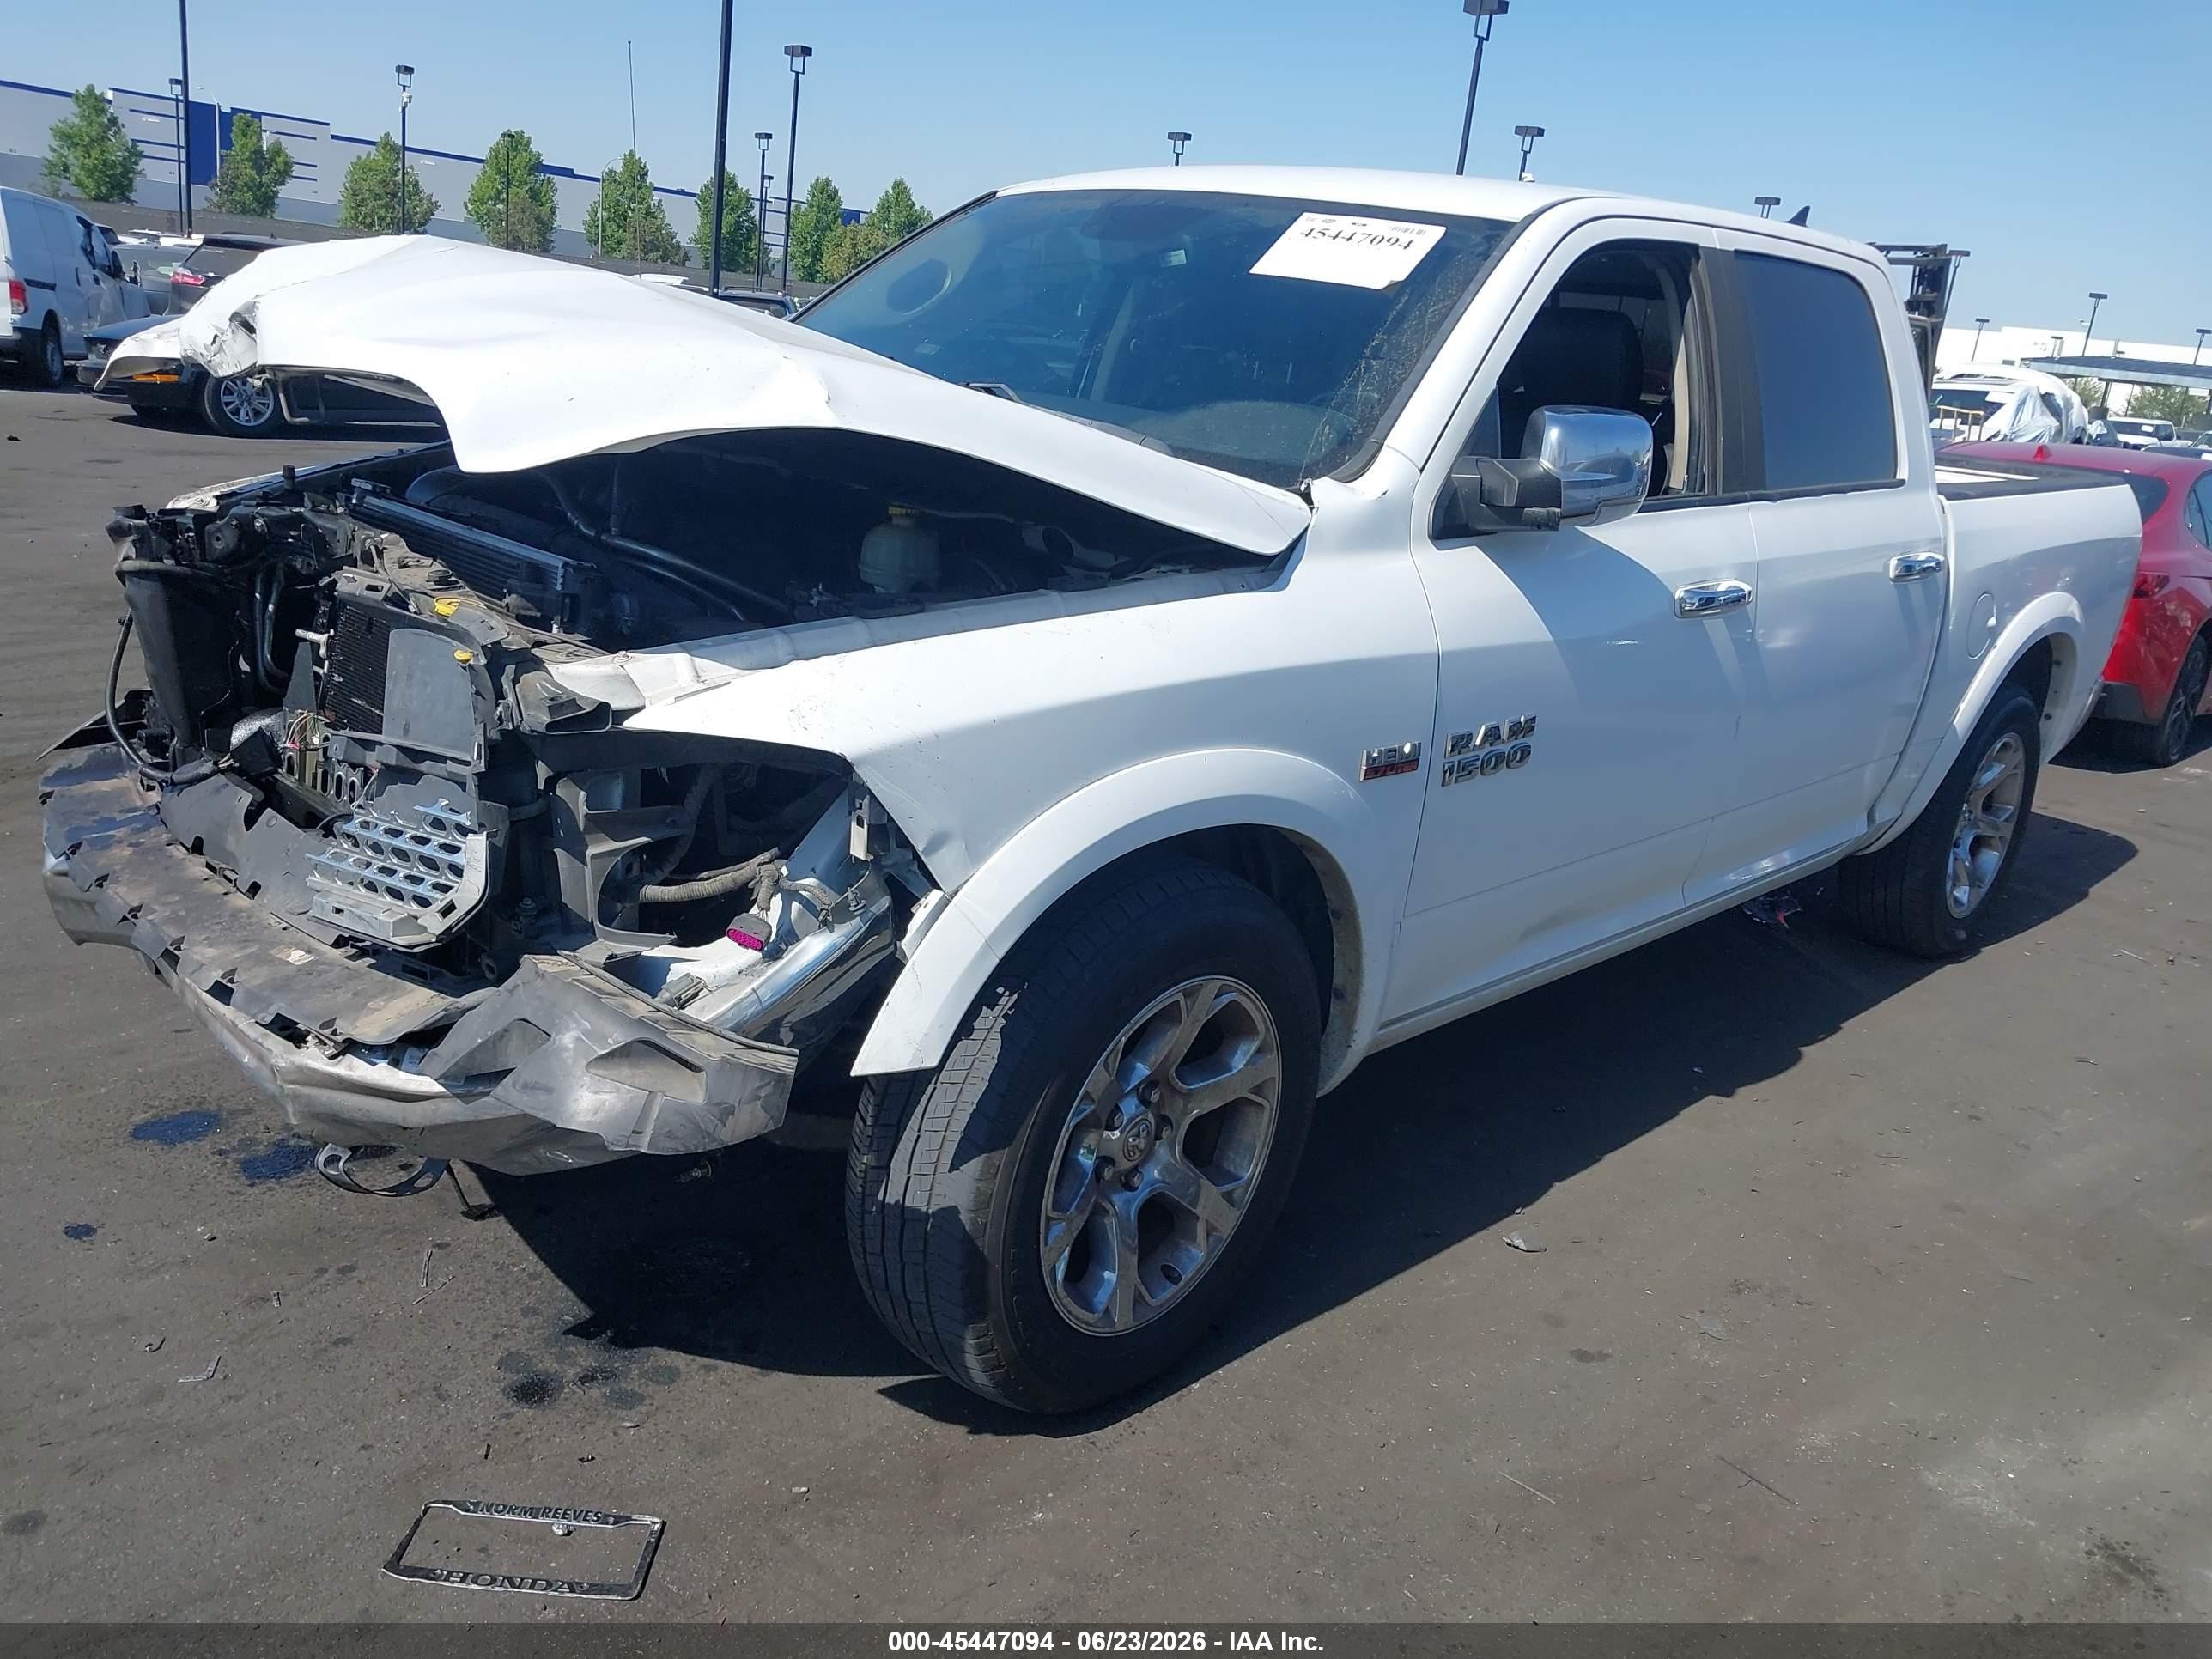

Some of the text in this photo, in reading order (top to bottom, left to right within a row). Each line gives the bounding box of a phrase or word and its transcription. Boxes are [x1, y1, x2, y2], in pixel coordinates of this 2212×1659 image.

[1301, 227, 1414, 250] 45447094
[1444, 714, 1536, 758] RAM
[1361, 741, 1421, 768] HEMI
[1441, 742, 1532, 787] 1500
[479, 1502, 602, 1523] NORM REEVES
[443, 1572, 577, 1593] HONDA
